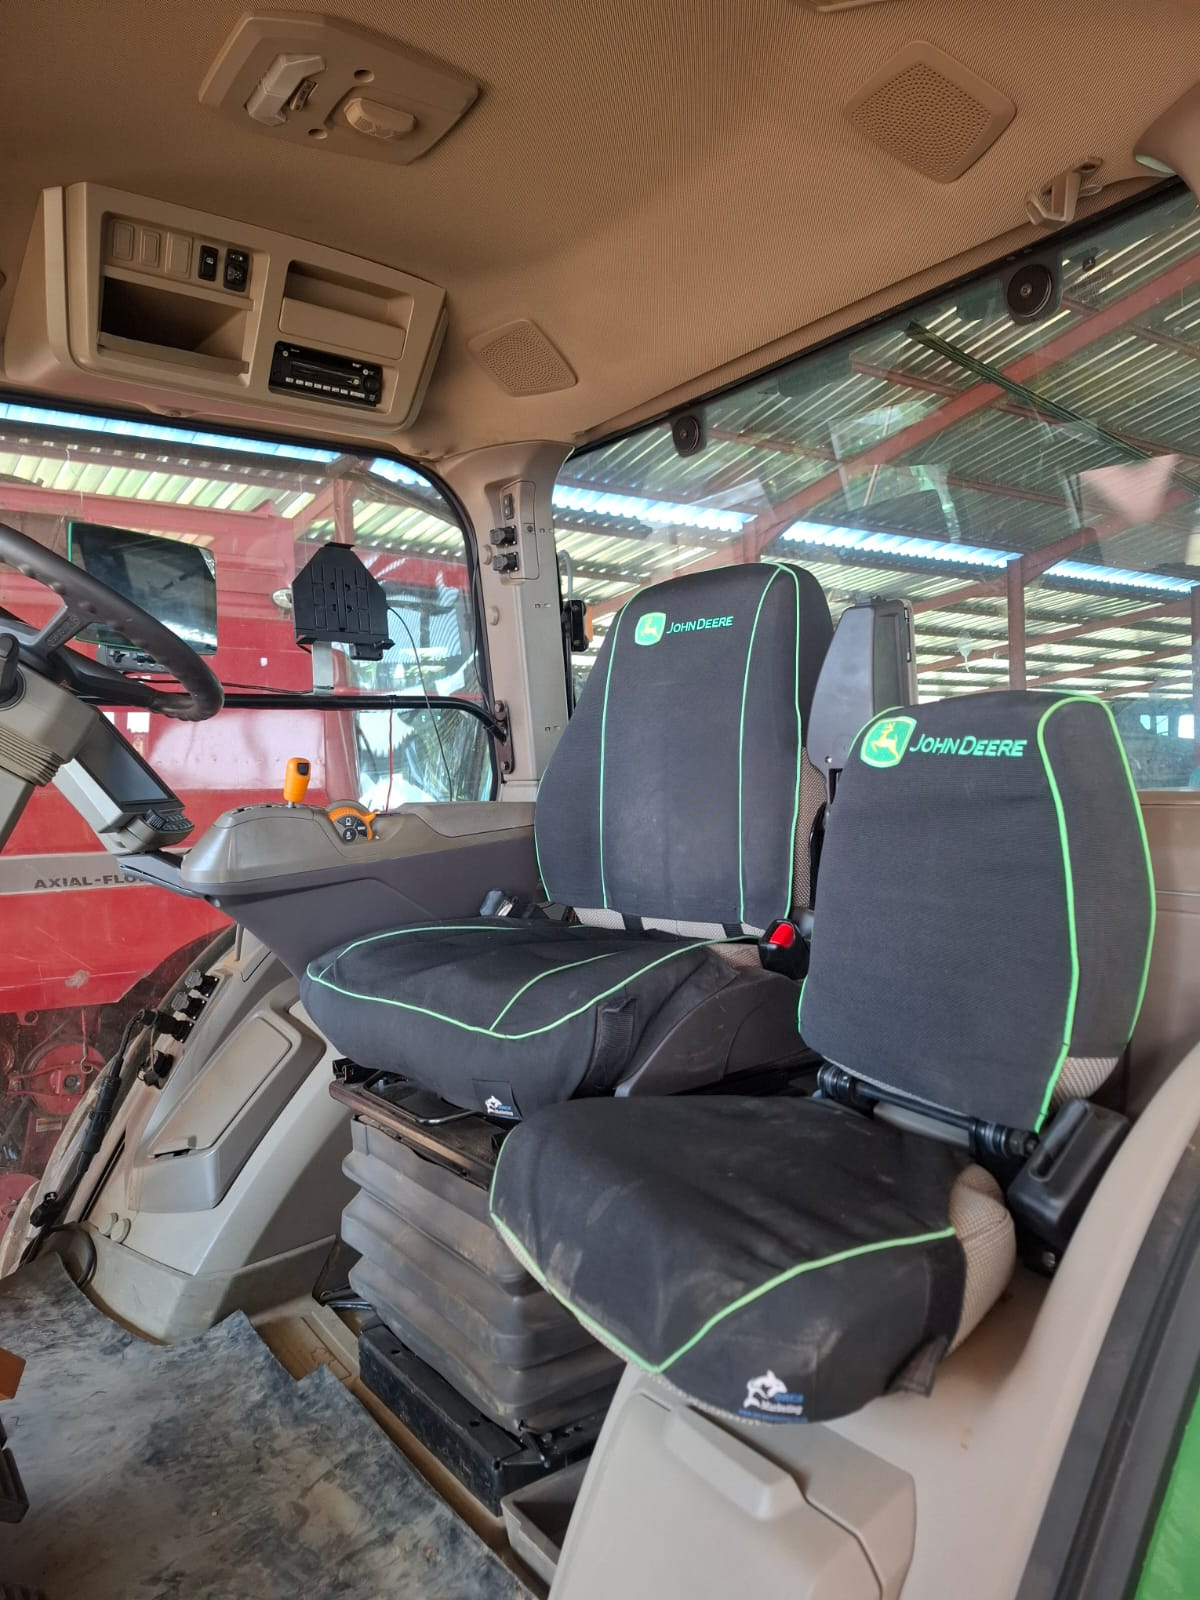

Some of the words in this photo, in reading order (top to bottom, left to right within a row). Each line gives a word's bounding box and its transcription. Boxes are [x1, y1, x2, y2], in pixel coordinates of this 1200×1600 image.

[666, 620, 697, 634] JOHN
[696, 616, 734, 630] DEERE
[909, 733, 961, 755] JOHN
[958, 735, 1028, 757] DEERE
[34, 873, 146, 889] AXIAL-FLO
